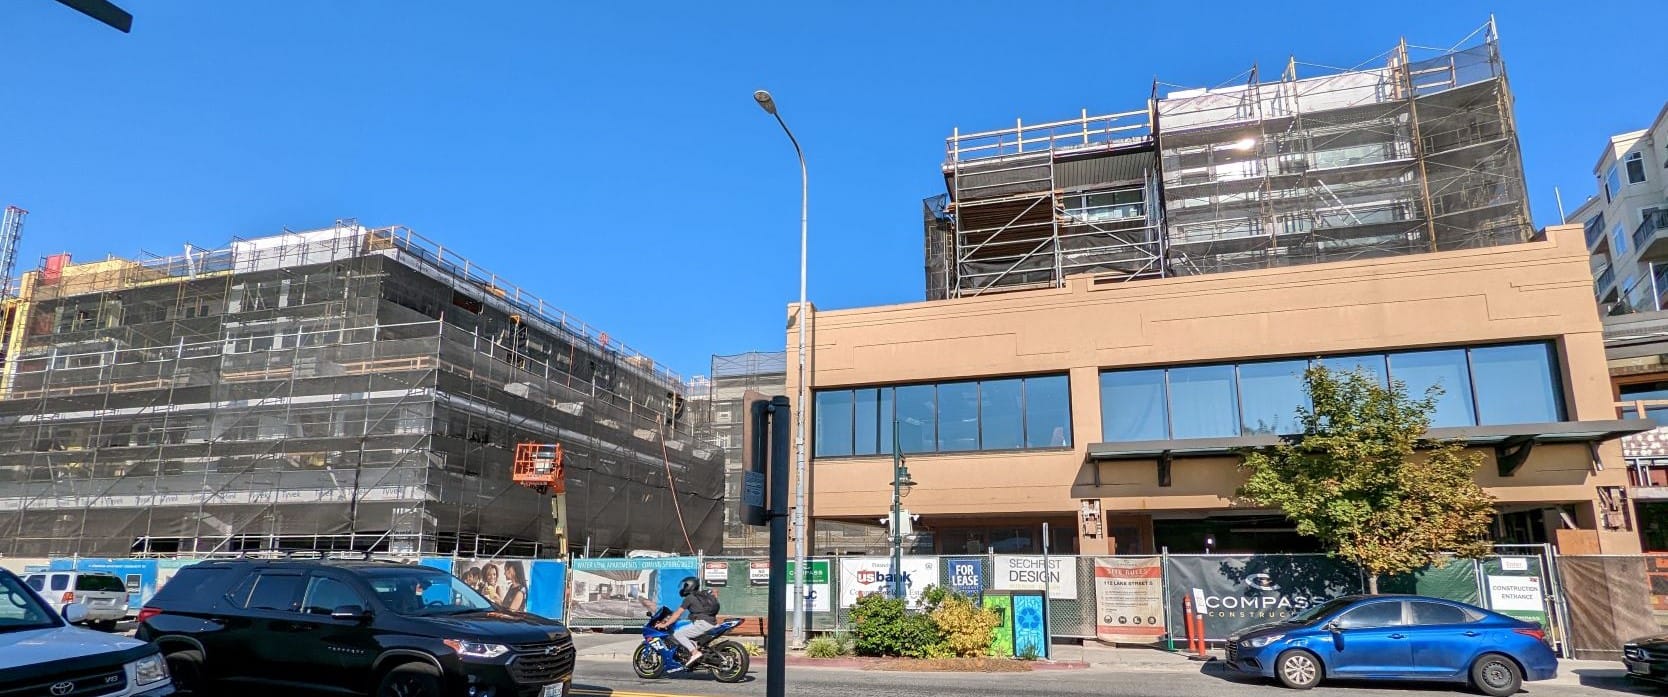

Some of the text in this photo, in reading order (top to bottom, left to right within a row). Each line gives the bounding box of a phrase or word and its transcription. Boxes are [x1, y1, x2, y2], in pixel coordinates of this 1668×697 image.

[1009, 559, 1061, 569] SECHRST
[956, 565, 974, 576] FOR
[952, 575, 979, 586] LEASE
[1009, 571, 1060, 583] DESIGN
[1206, 596, 1325, 609] COMPASS
